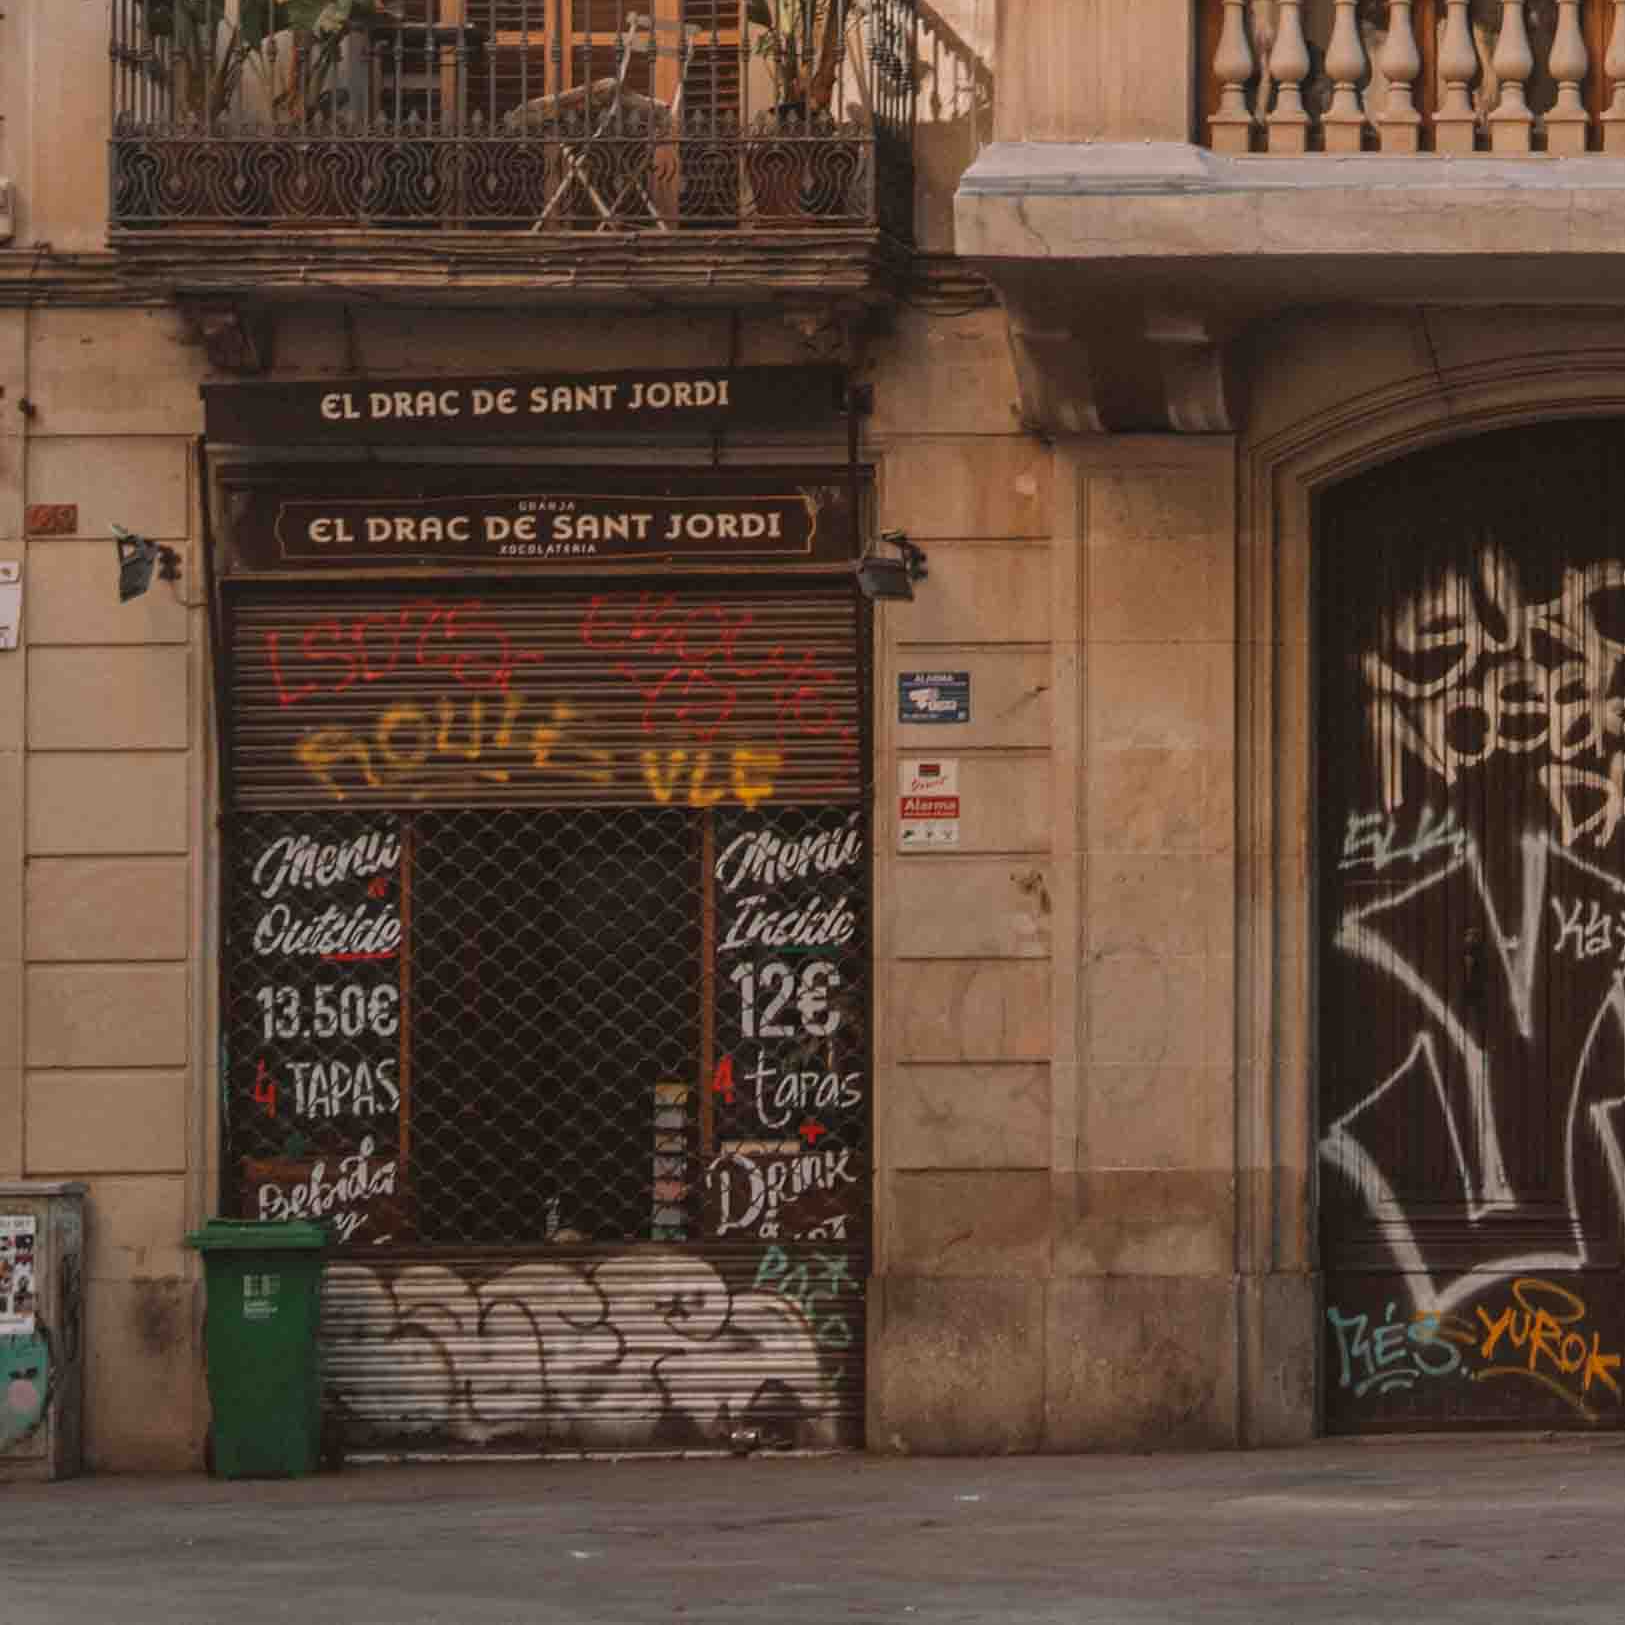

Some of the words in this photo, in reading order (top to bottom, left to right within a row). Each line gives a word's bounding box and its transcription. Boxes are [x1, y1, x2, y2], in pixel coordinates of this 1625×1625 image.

[321, 393, 360, 419] EL
[369, 390, 460, 418] DRAC
[471, 388, 518, 415] DE
[529, 384, 618, 413] SANT
[628, 380, 729, 409] JORDI
[308, 517, 355, 543] EL
[366, 516, 470, 543] DRAC
[484, 515, 537, 541] DE
[552, 513, 653, 540] SANT
[664, 512, 782, 540] JORDI
[500, 542, 597, 557] XOCOLATERIA
[904, 798, 957, 811] Alarma
[252, 816, 401, 899] Menú
[715, 811, 864, 893] Menú
[717, 895, 855, 952] Inside
[256, 984, 398, 1044] 13.50€
[729, 960, 841, 1038] 12€
[254, 1055, 277, 1118] 4
[285, 1057, 400, 1119] TAPAS
[711, 1053, 734, 1103] 4
